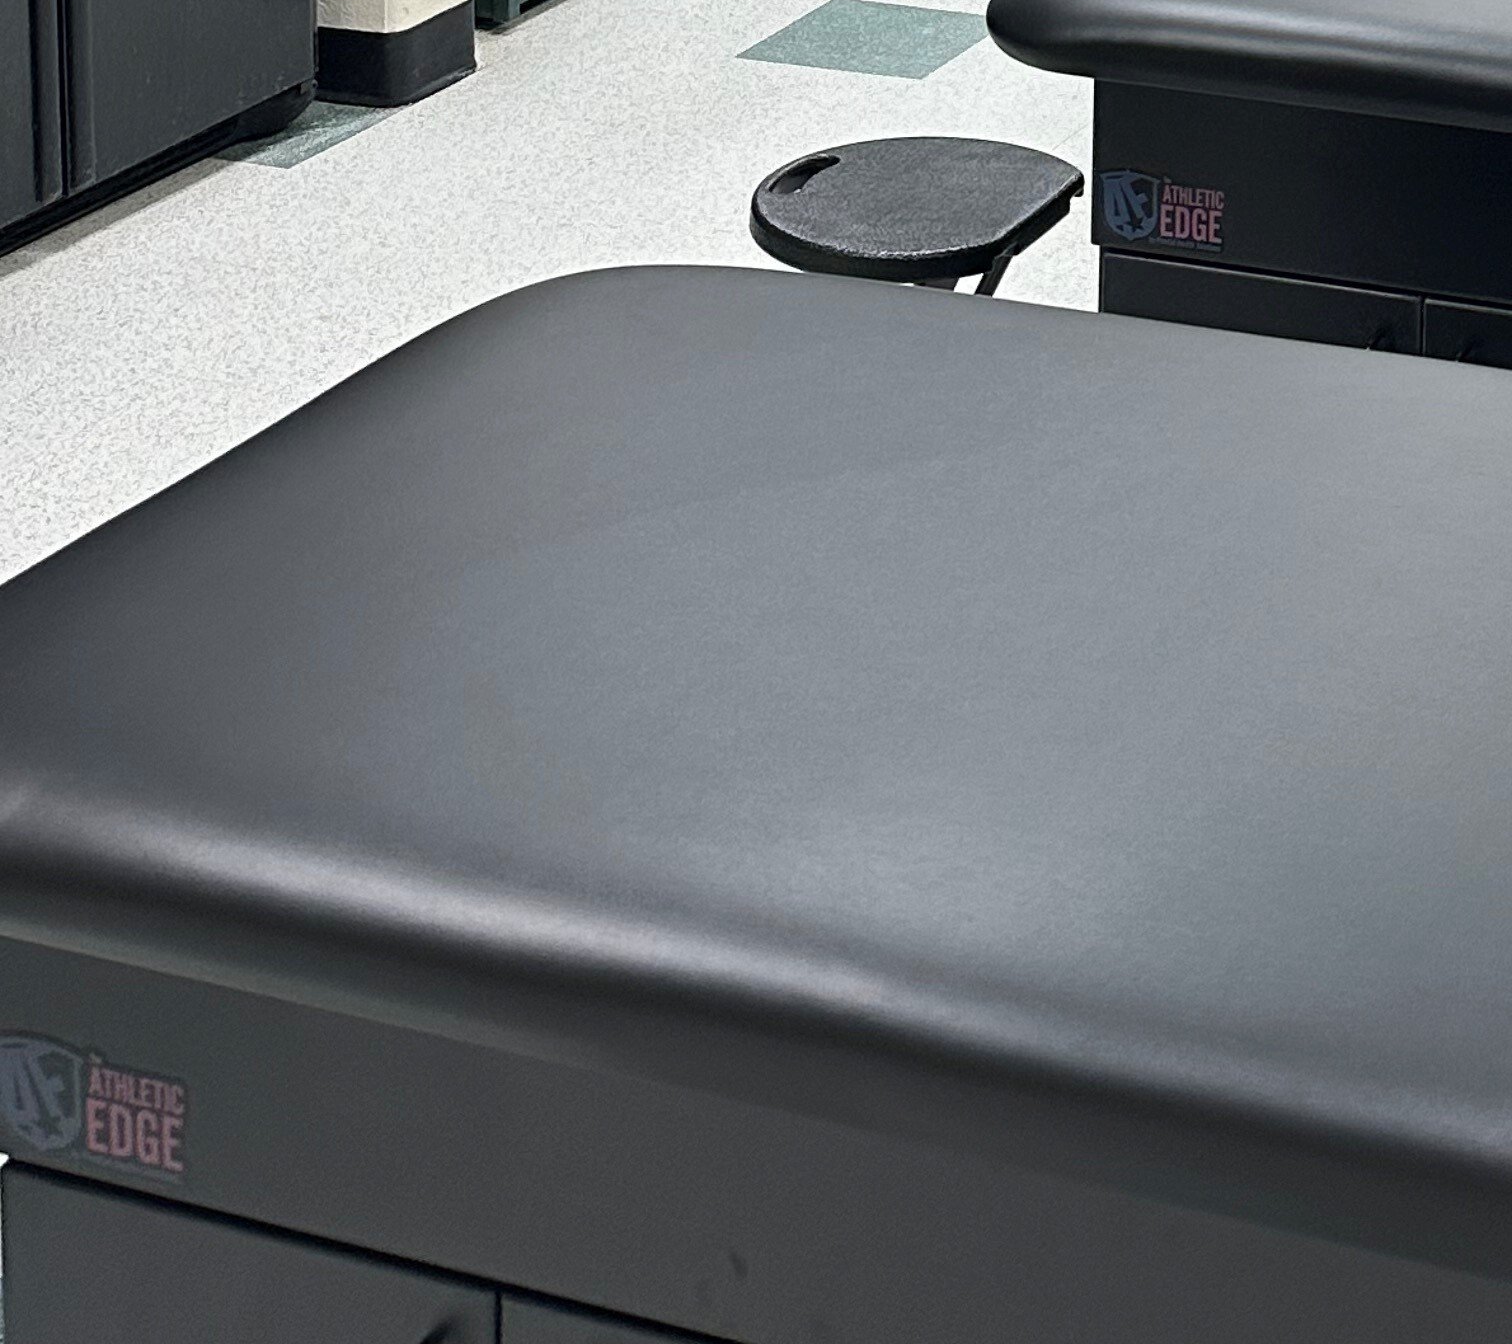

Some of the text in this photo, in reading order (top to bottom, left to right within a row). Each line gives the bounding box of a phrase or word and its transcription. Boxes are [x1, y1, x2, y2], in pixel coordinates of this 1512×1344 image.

[1162, 184, 1225, 209] ATHLETIC
[1159, 203, 1223, 244] EDGE
[88, 1065, 186, 1115] ATHLETIC
[86, 1097, 184, 1172] EDGE
